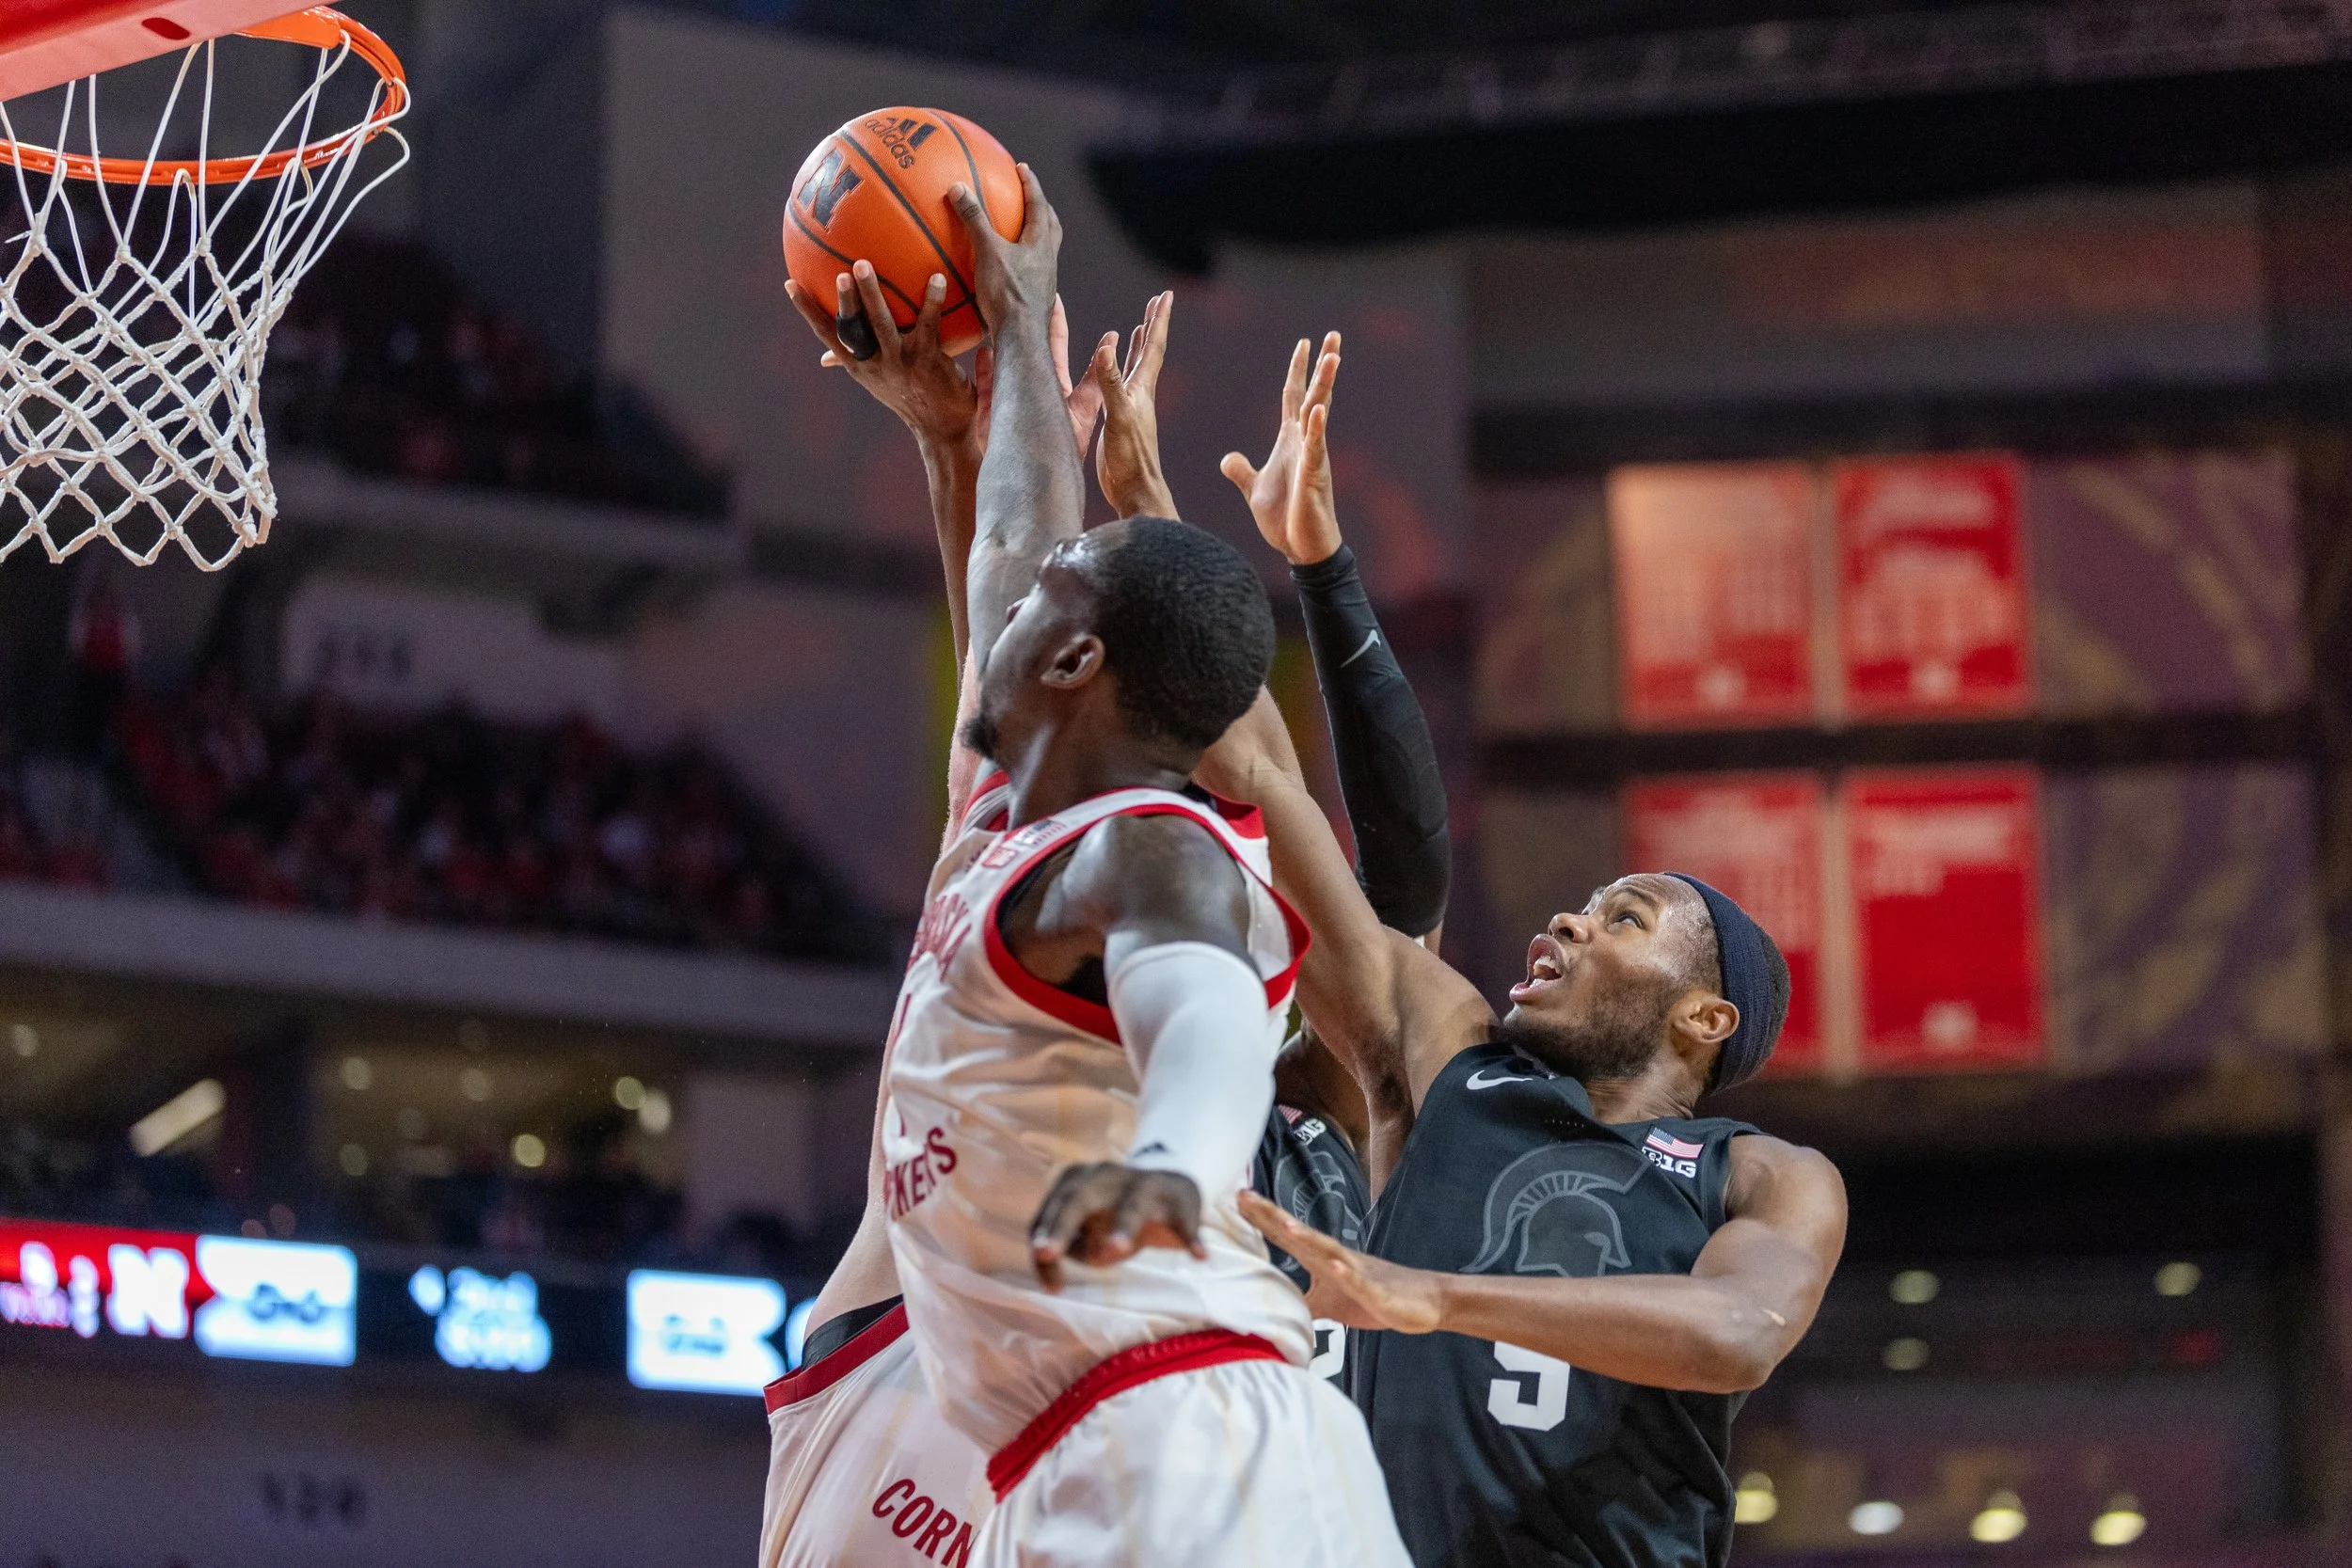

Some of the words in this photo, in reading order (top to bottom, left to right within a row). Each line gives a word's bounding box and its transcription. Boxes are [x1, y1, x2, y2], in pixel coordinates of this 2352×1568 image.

[865, 119, 915, 169] adidas
[797, 149, 865, 232] N
[872, 1478, 980, 1568] CORN
